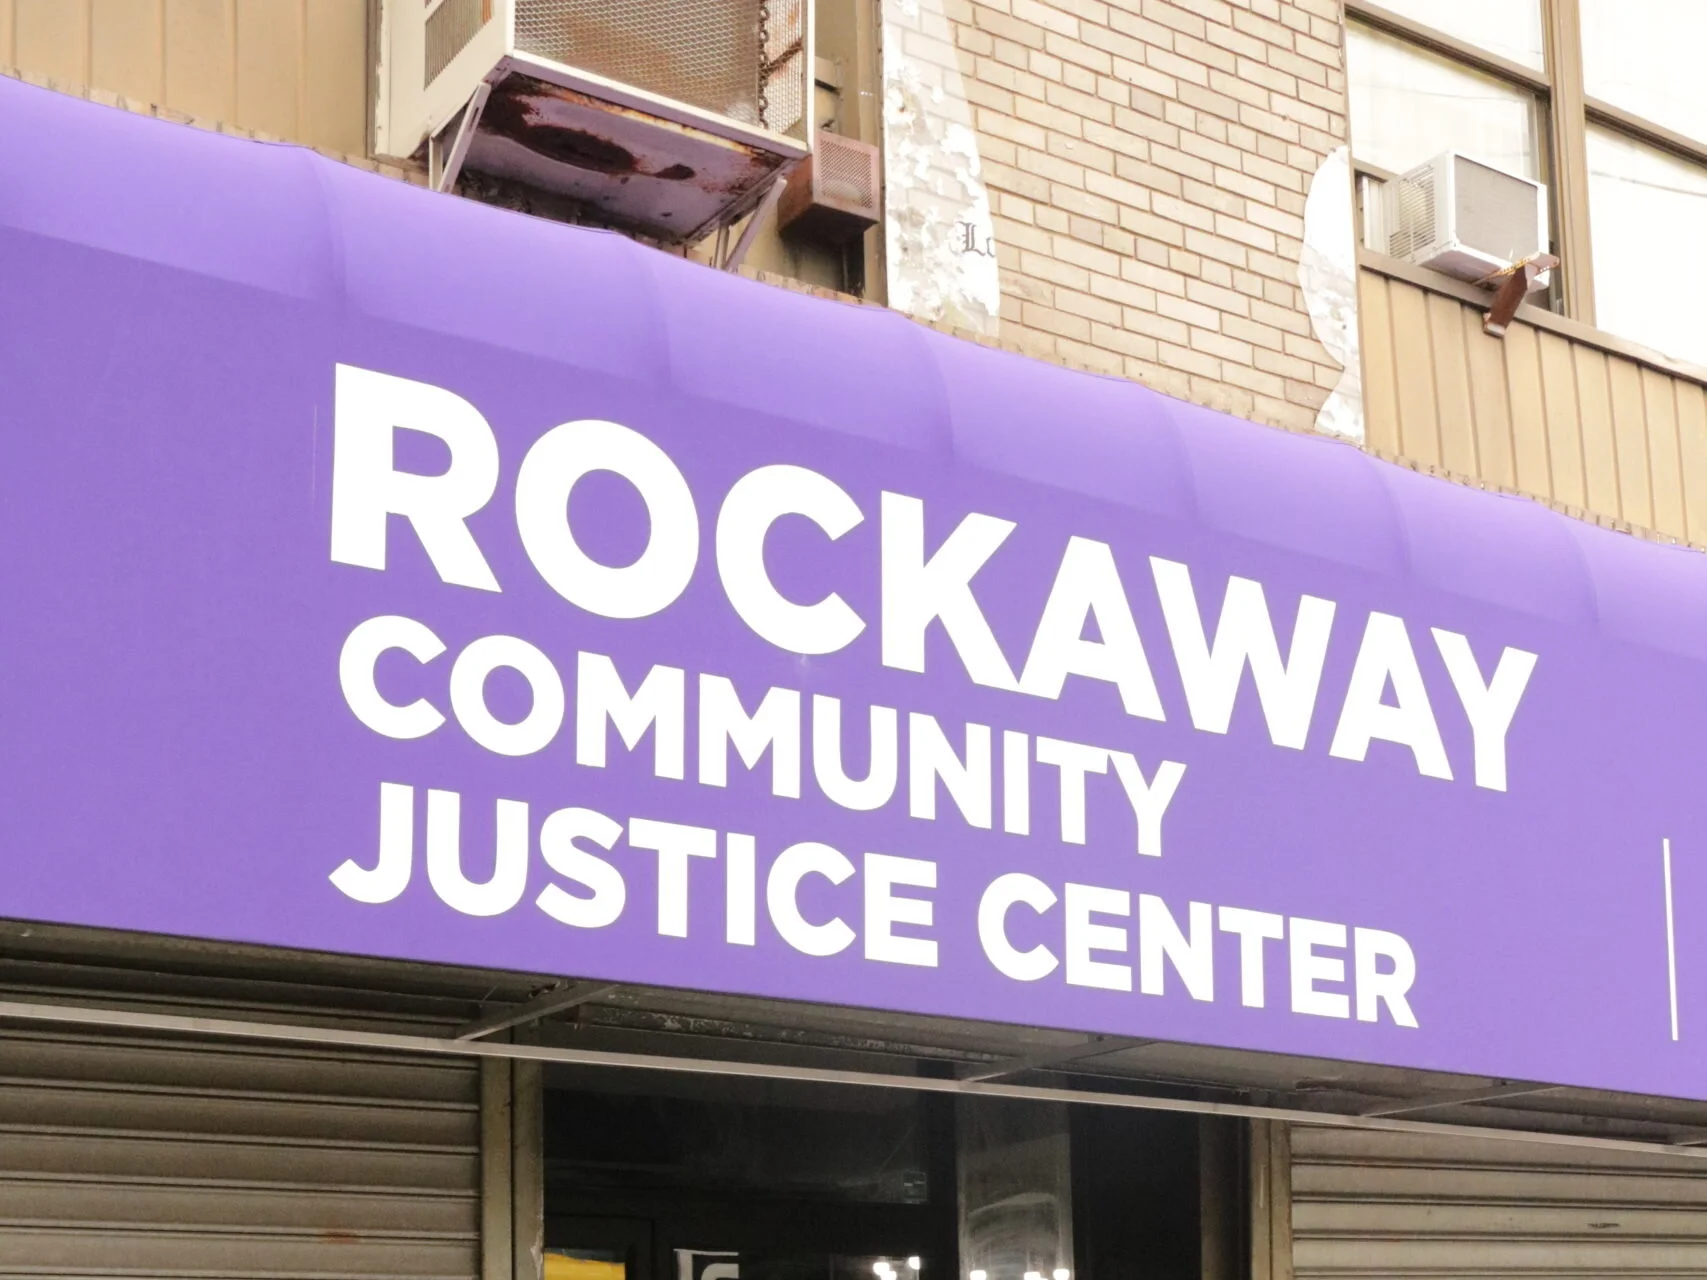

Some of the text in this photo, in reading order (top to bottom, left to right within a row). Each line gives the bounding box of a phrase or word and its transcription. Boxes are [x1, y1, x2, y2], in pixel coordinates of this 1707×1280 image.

[329, 363, 1538, 792] ROCKAWAY
[339, 615, 1186, 857] COMMUNITY
[329, 782, 1419, 1028] JUSTICE CENTER
